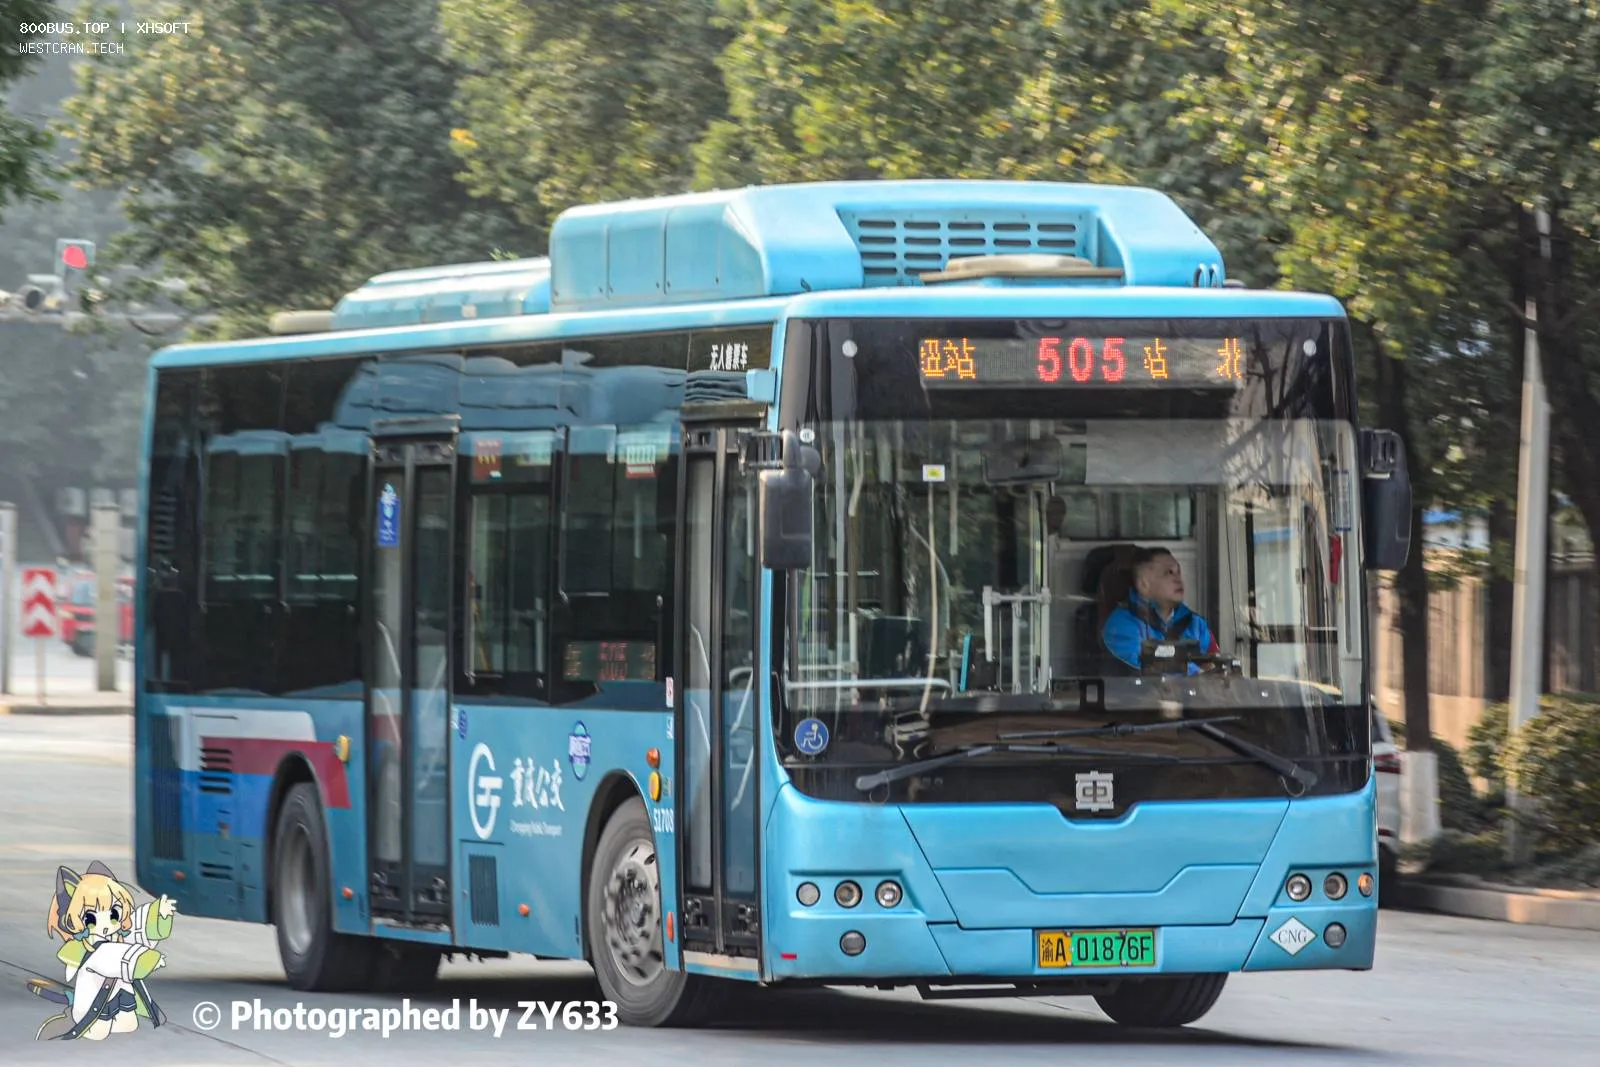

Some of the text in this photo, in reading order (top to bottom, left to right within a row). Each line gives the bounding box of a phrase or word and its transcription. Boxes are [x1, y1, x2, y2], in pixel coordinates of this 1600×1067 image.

[1037, 337, 1126, 382] 505
[1041, 936, 1151, 962] 渝A 01876F
[1278, 929, 1307, 944] CNG
